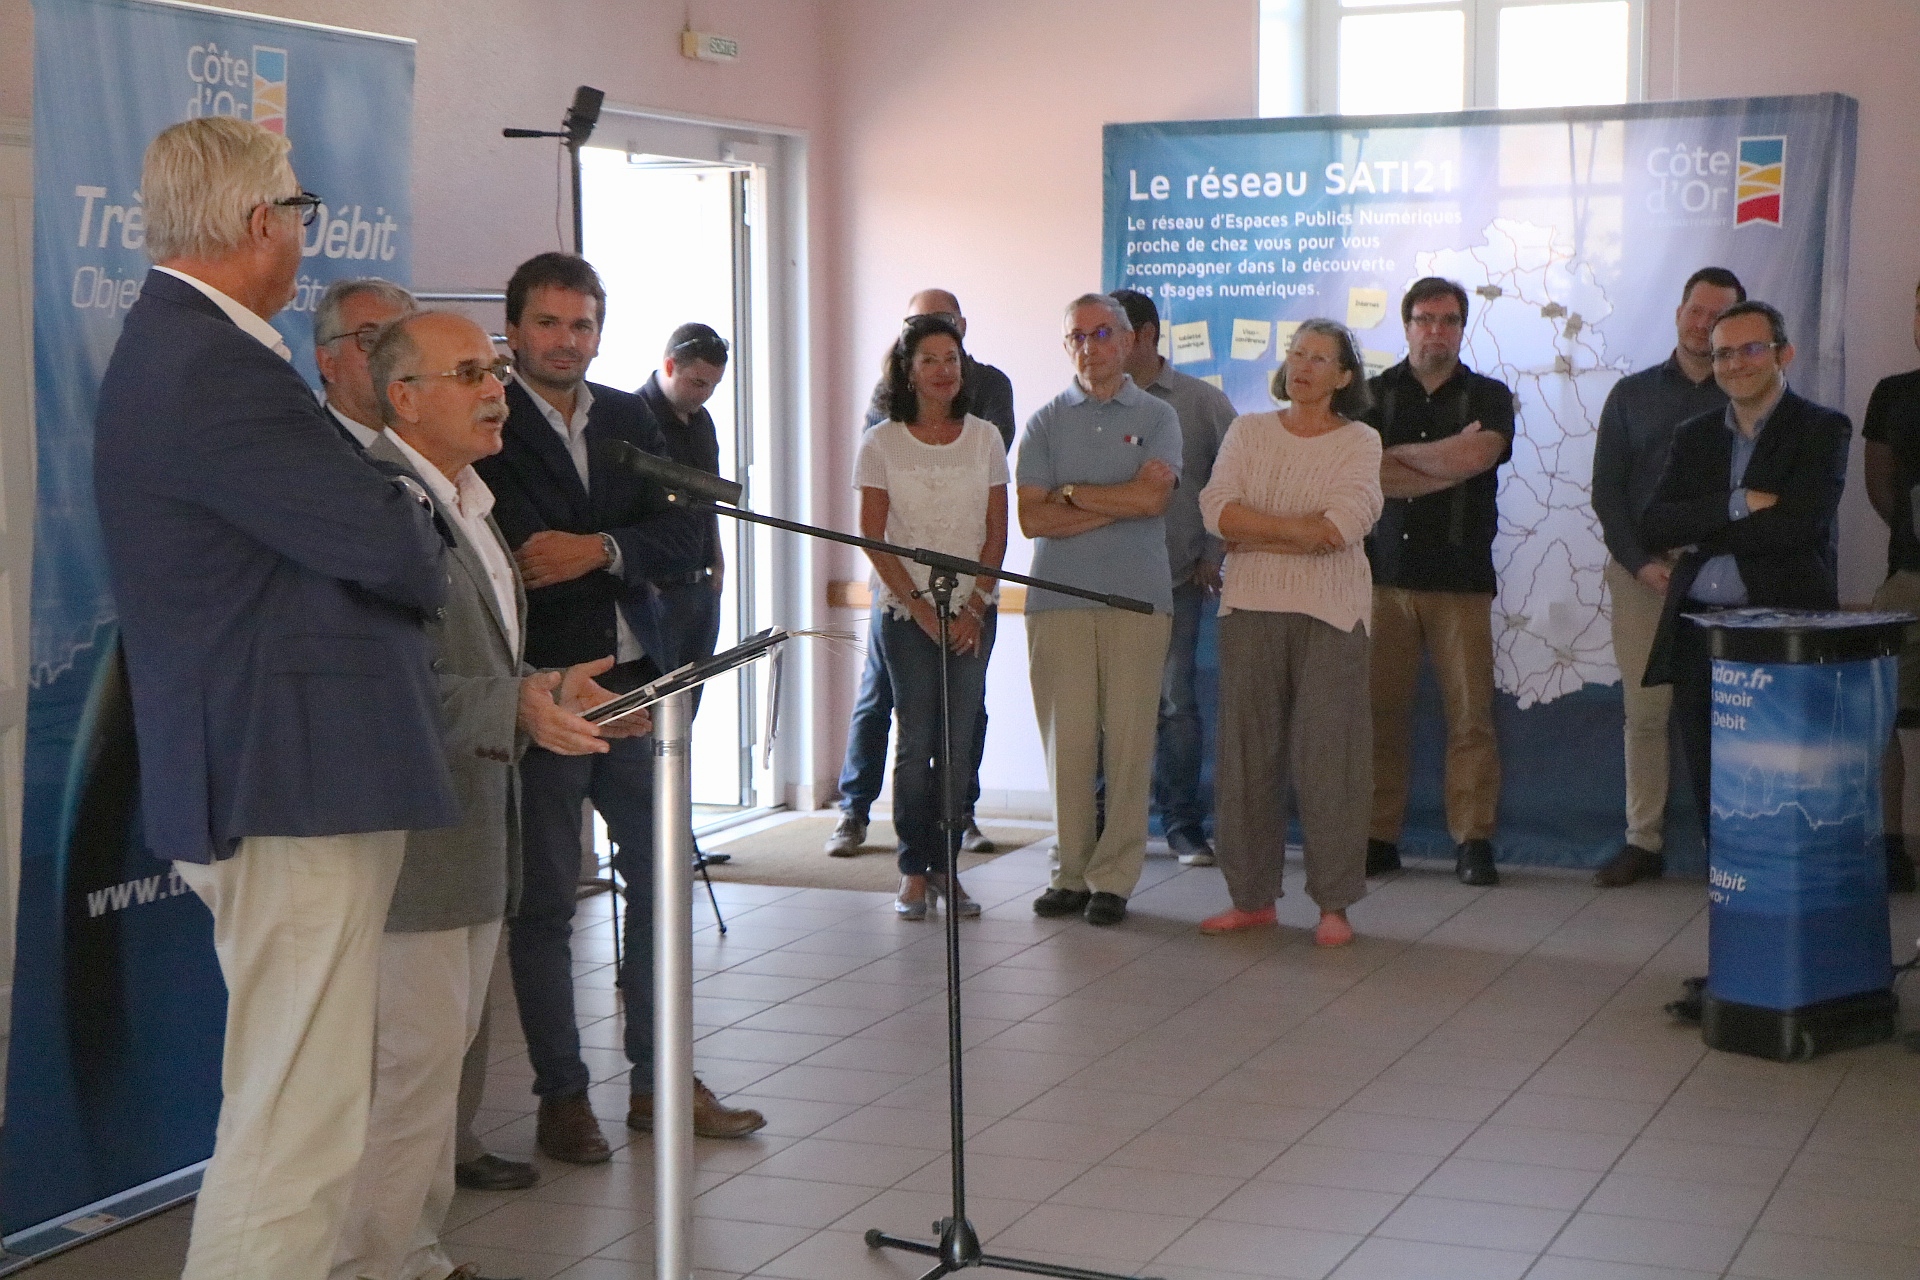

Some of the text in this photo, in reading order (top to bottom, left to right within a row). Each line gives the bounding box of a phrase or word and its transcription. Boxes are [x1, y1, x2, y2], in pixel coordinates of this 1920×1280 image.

[187, 42, 249, 87] Côte
[1647, 142, 1730, 177] Côte
[1129, 160, 1456, 201] Le réseau SATI21
[1646, 178, 1728, 213] d'Or
[75, 185, 397, 261] Trè Débit
[1127, 209, 1463, 232] Le réseau d'Espaces Publics Numériques
[1126, 236, 1380, 256] proche de chez vous pour vous
[1126, 256, 1396, 278] accompagner dans la découverte
[71, 265, 143, 318] Obje
[1159, 283, 1214, 300] usages
[1219, 280, 1320, 300] numériques.
[1712, 666, 1774, 690] dor.fr
[1714, 690, 1754, 708] savoir
[1713, 711, 1747, 731] Débit
[1709, 865, 1747, 892] Débit
